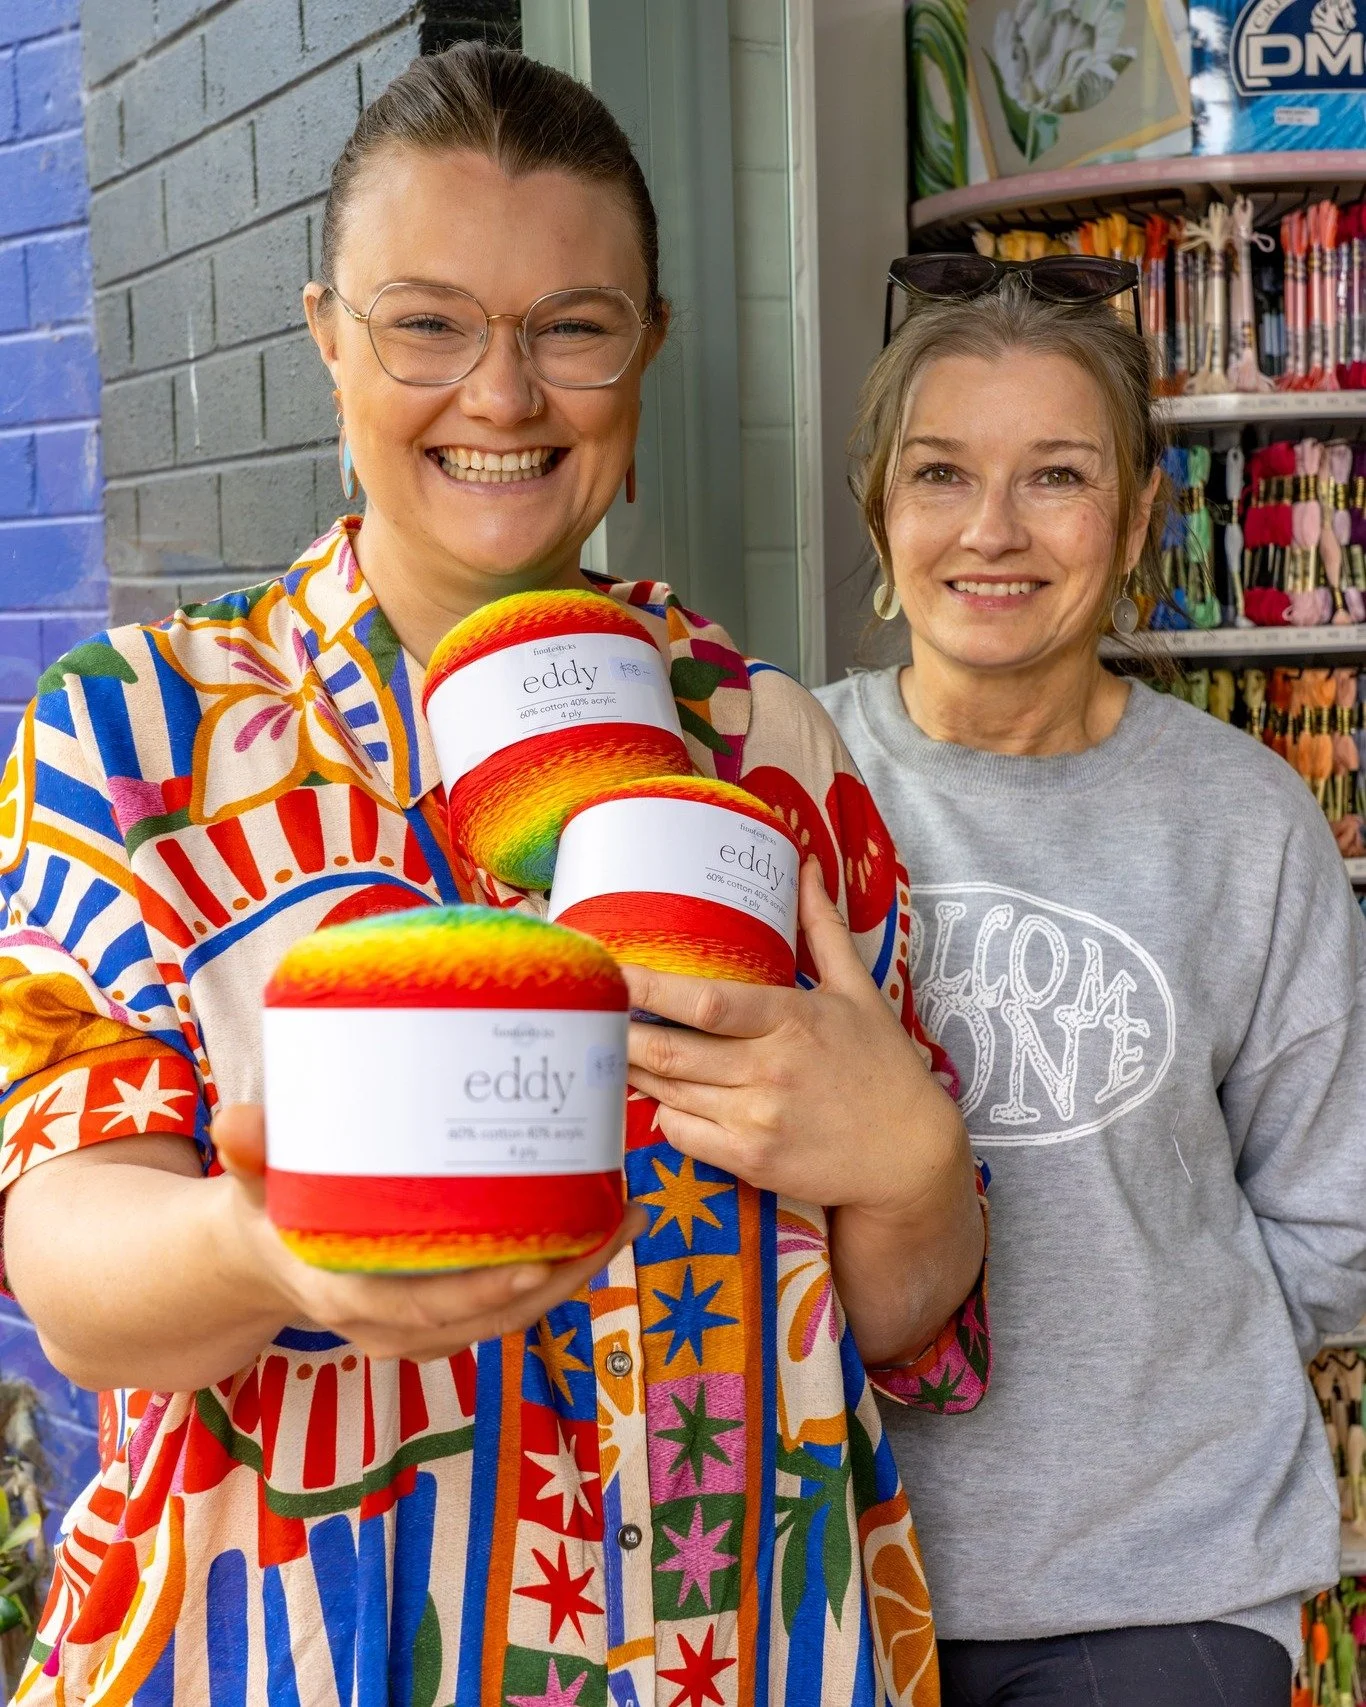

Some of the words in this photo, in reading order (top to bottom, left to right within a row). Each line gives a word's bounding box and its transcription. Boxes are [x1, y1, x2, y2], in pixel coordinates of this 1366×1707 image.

[1248, 33, 1366, 77] DM
[523, 659, 598, 694] eddy
[519, 707, 539, 720] 60%
[540, 701, 569, 714] cotton
[570, 698, 589, 707] 40%
[590, 696, 617, 706] acrylic
[560, 711, 567, 719] 4
[568, 709, 582, 720] ply
[720, 844, 785, 891] eddy
[706, 872, 725, 884] 60%
[726, 879, 753, 894] cotton
[754, 889, 769, 903] 40%
[769, 899, 787, 917] acrylic
[742, 895, 748, 903] 4
[749, 899, 761, 911] ply
[463, 1055, 576, 1115] eddy
